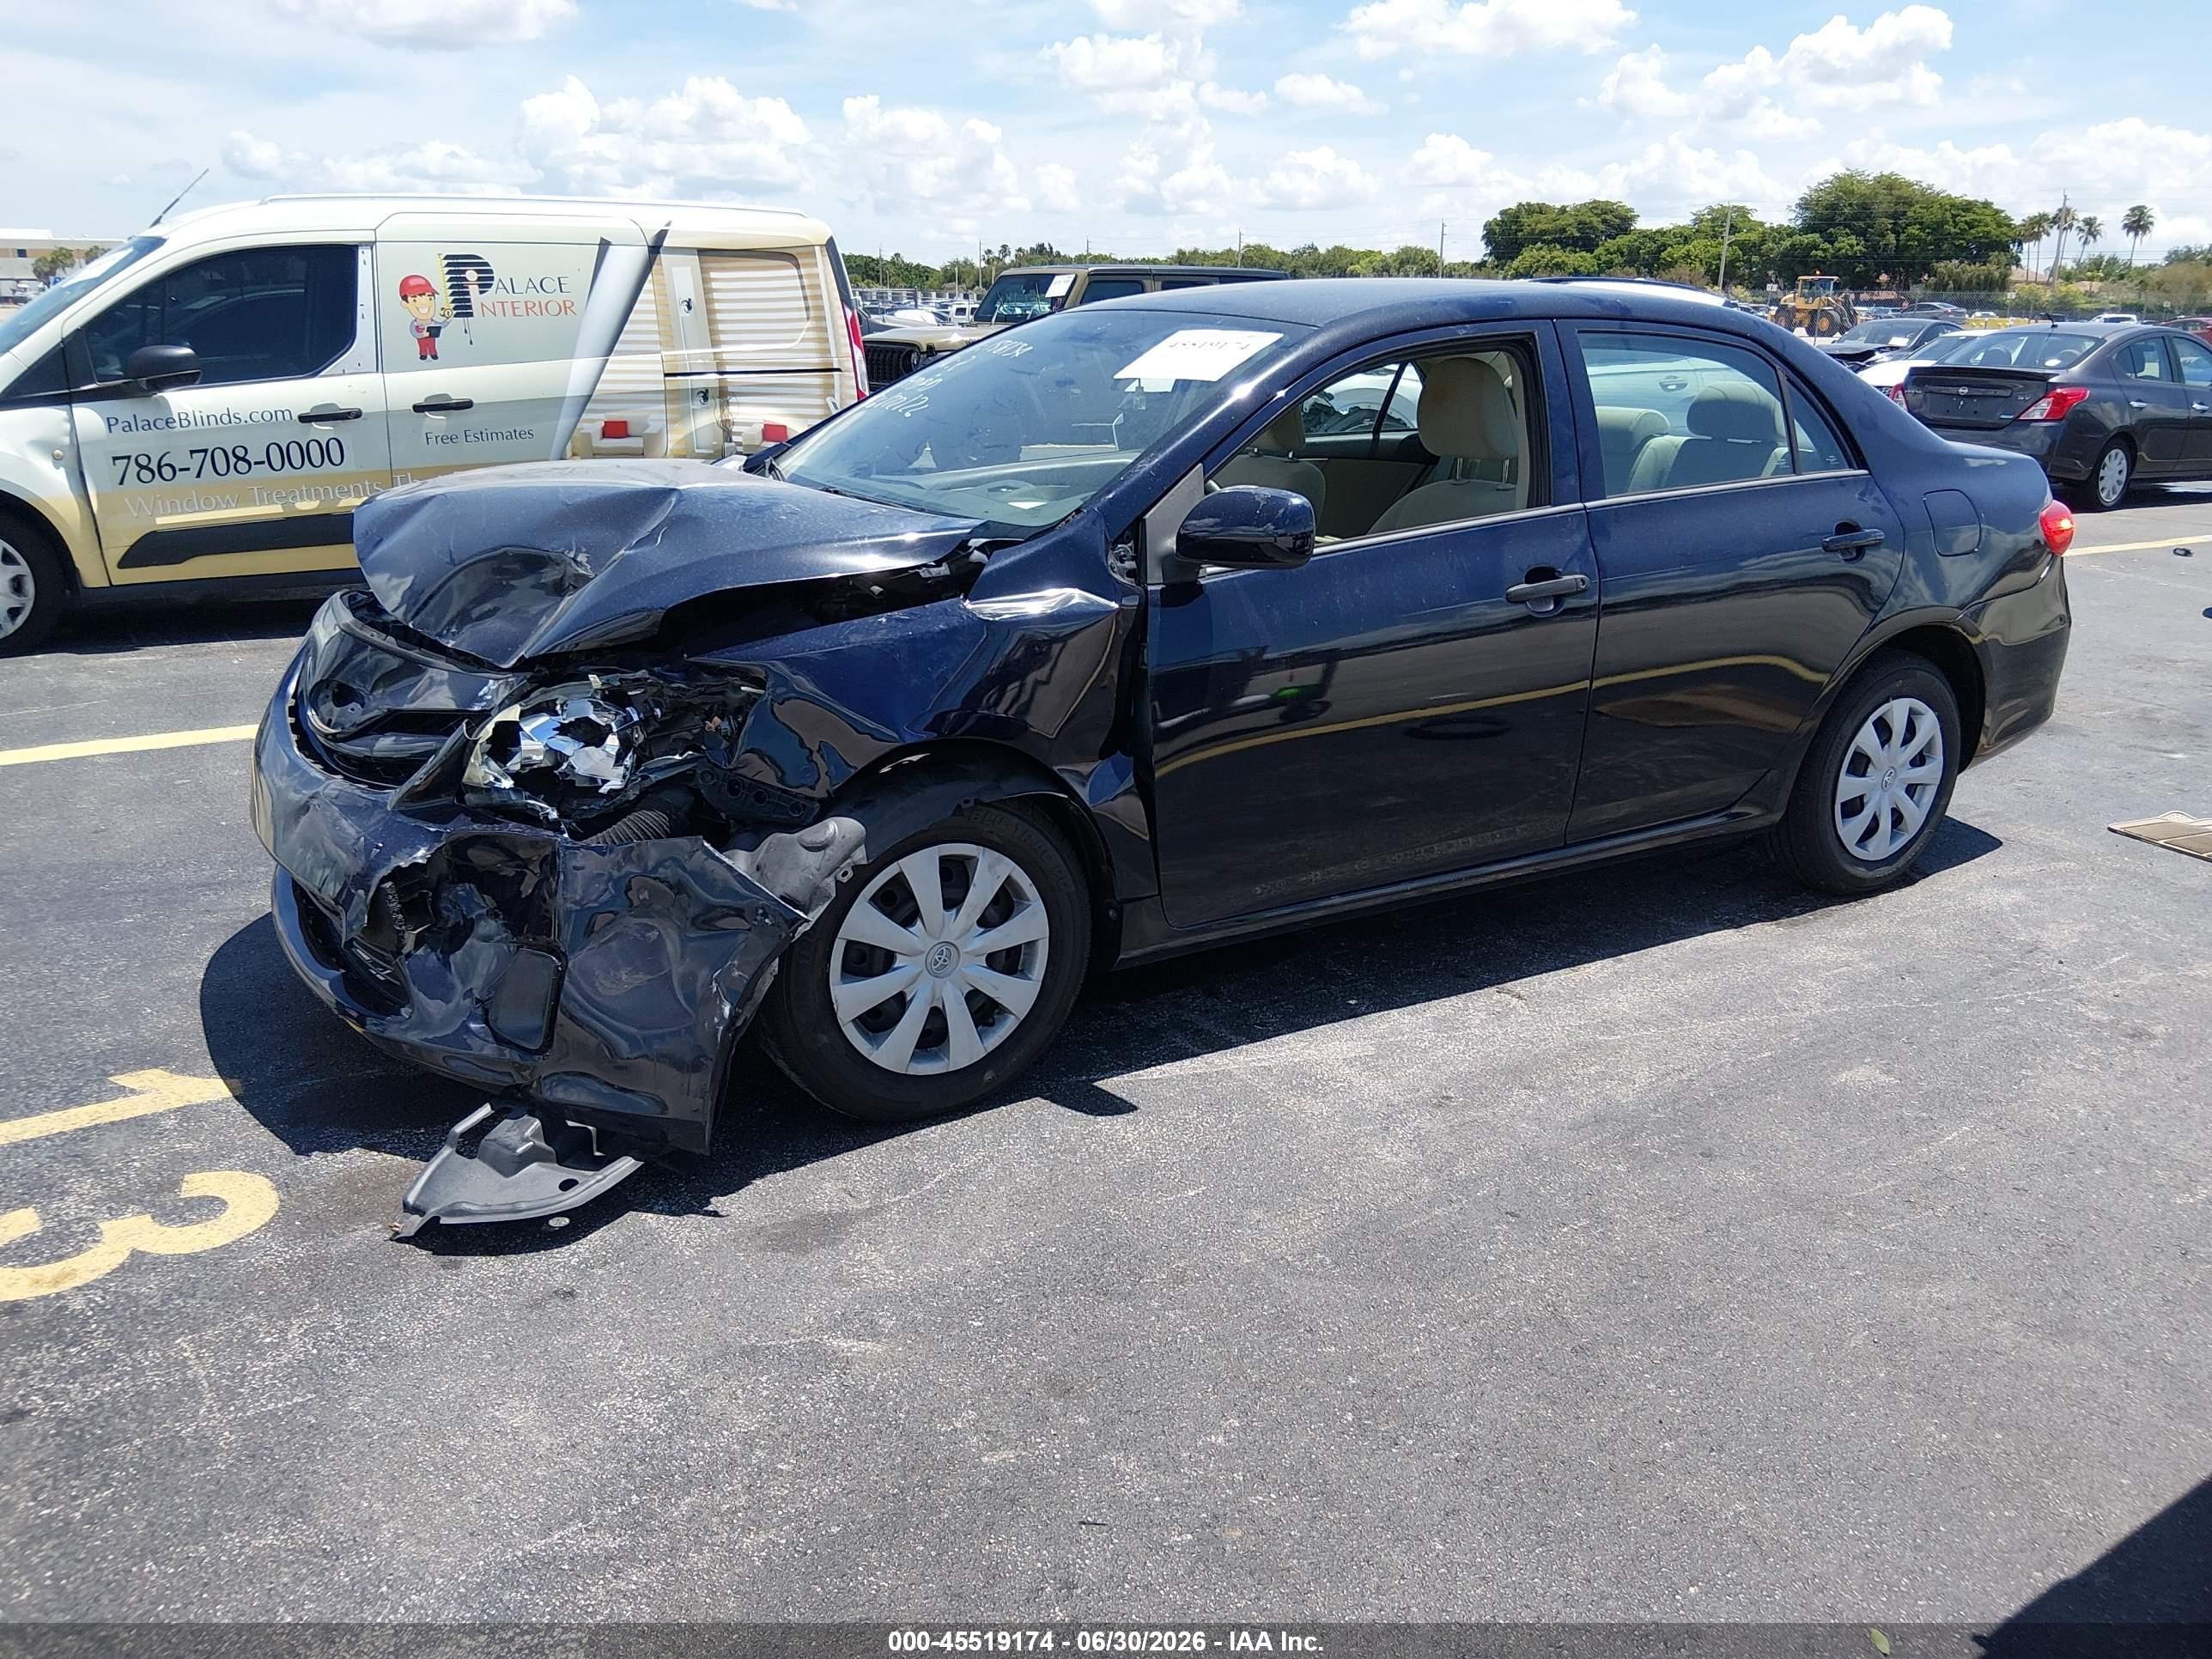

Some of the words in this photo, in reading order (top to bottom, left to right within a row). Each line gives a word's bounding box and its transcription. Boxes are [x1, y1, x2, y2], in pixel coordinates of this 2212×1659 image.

[442, 254, 572, 318] PALACE
[106, 407, 294, 434] PalaceBlinds.com
[425, 431, 459, 446] Free
[465, 428, 535, 443] Estimates
[112, 437, 345, 486] 786-708-0000
[125, 489, 239, 517] Window
[246, 479, 386, 506] Treatments
[392, 472, 420, 487] Th
